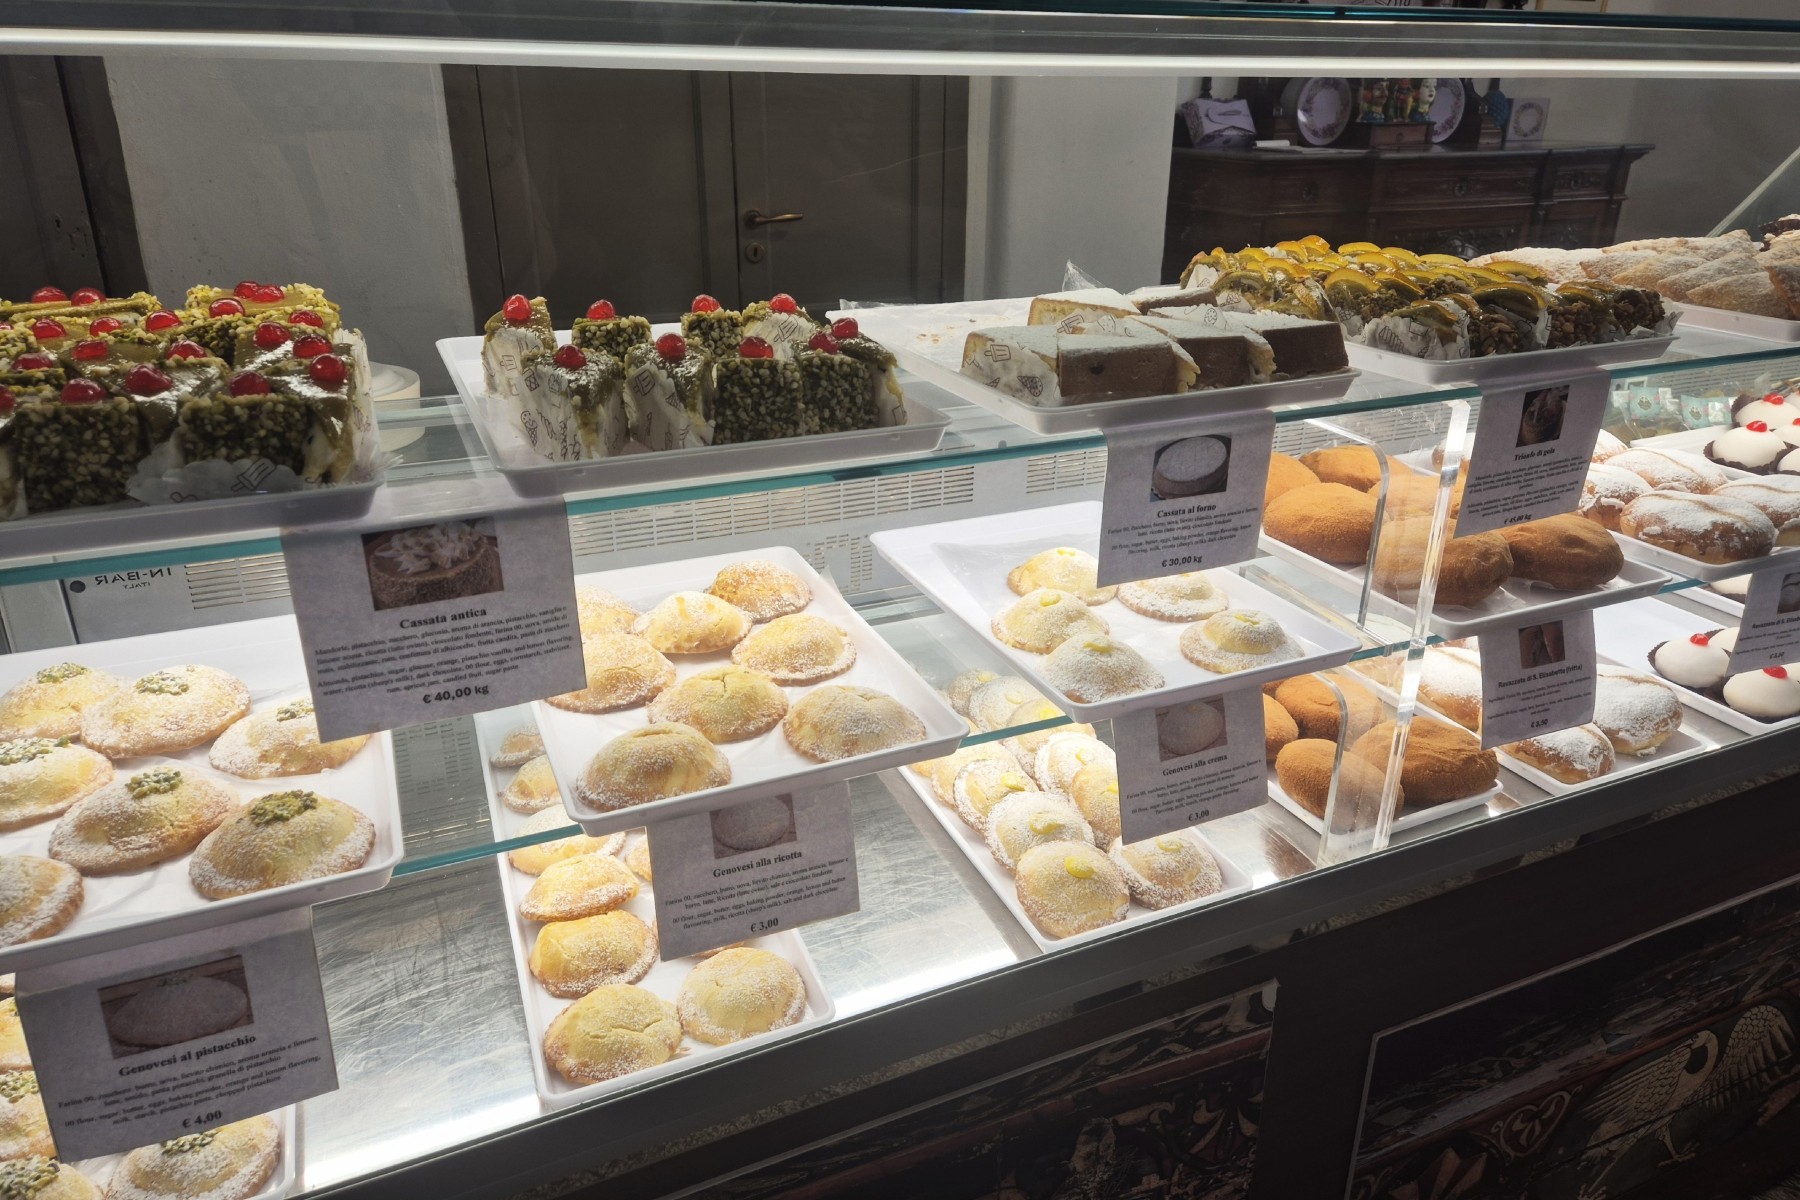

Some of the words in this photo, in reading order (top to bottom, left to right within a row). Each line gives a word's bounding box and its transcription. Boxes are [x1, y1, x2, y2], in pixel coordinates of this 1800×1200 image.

[1157, 509, 1186, 518] Cassata
[1196, 504, 1216, 513] forno
[1161, 559, 1168, 568] €
[1168, 555, 1192, 566] 30,00
[1193, 555, 1202, 563] kg
[399, 615, 447, 630] Cassata
[450, 607, 487, 622] antica
[422, 693, 432, 704] €
[434, 686, 472, 702] 40,00
[474, 684, 490, 696] kg
[1162, 762, 1193, 776] Genovesi
[1194, 759, 1206, 768] alla
[1207, 755, 1228, 764] crema
[1188, 814, 1193, 822] €
[712, 860, 753, 877] Genovesi
[755, 857, 772, 868] alla
[773, 851, 802, 863] ricotta
[750, 922, 757, 932] €
[759, 917, 778, 930] 3,00
[118, 1054, 177, 1077] Genovesi
[180, 1050, 192, 1063] al
[195, 1034, 256, 1060] pistacchio
[181, 1118, 191, 1129] €
[193, 1109, 223, 1125] 4,00
